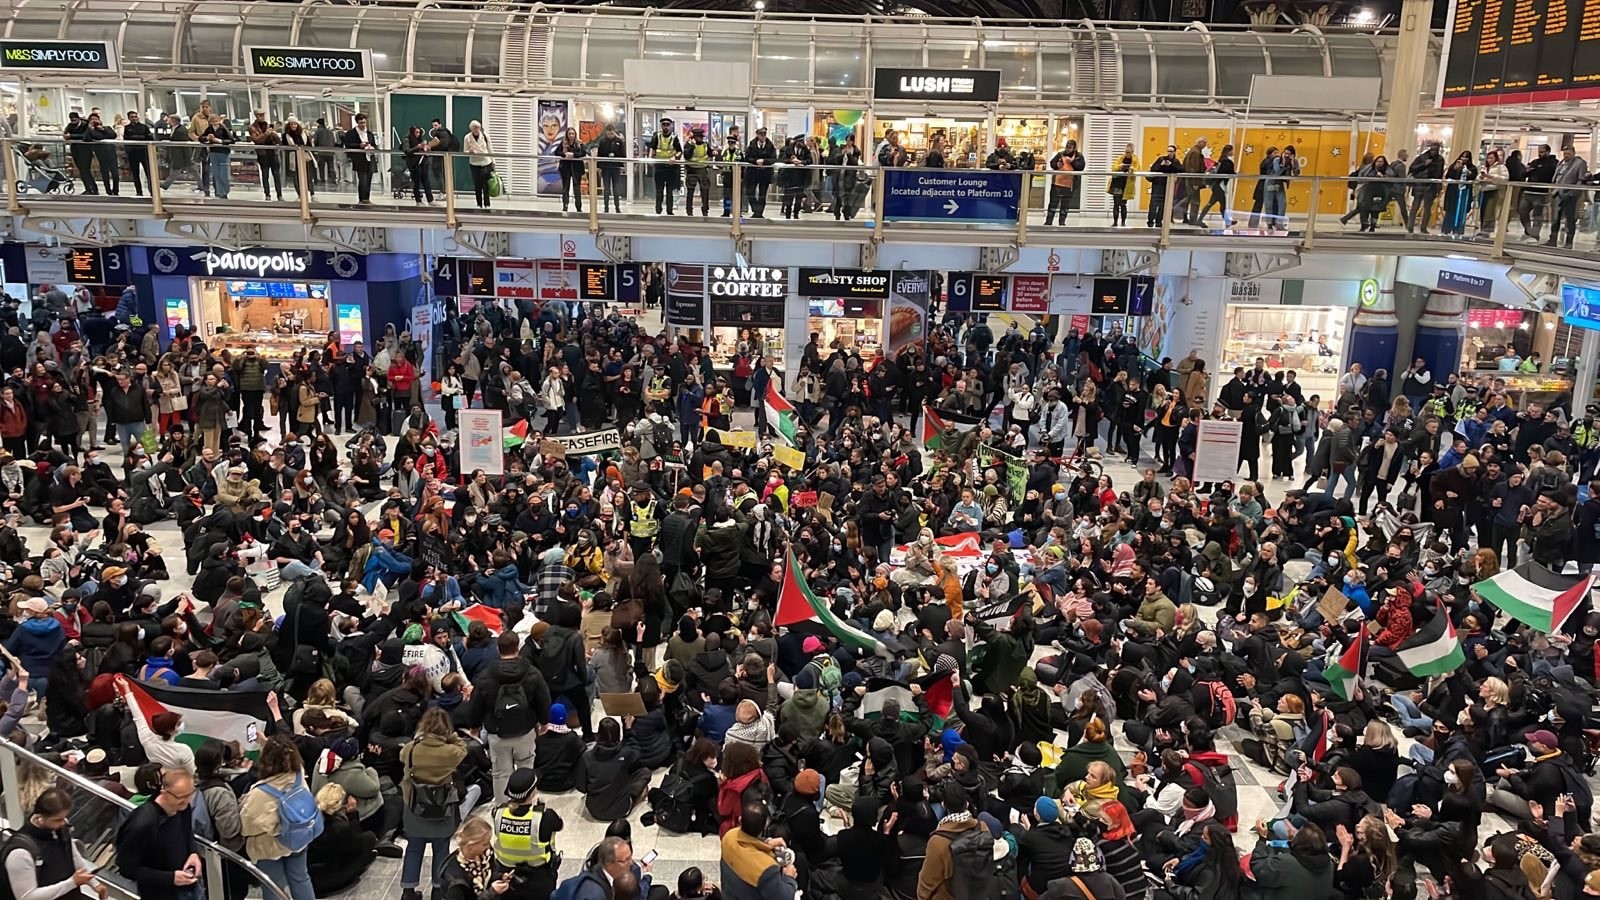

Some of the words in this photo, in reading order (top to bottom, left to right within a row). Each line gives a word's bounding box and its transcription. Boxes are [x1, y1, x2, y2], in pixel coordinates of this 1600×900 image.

[6, 49, 31, 60] M&S
[31, 49, 66, 61] SIMPLY
[67, 50, 100, 62] FOOD
[259, 56, 285, 68] M&S
[286, 56, 321, 69] SIMPLY
[322, 58, 356, 70] FOOD
[900, 76, 950, 93] LUSH
[918, 177, 956, 186] Customer
[958, 178, 988, 187] Lounge
[891, 187, 920, 196] located
[922, 189, 955, 198] adjacent
[967, 190, 1001, 198] Platform
[1003, 190, 1014, 198] 10
[108, 252, 121, 270] 3
[206, 251, 306, 277] panopolis
[438, 263, 452, 280] 4
[622, 270, 634, 287] 5
[726, 267, 770, 281] AMT
[856, 276, 887, 285] SHOP
[712, 281, 783, 297] COFFEE
[954, 280, 967, 296] 6
[1136, 283, 1149, 296] 7
[1231, 282, 1260, 296] wasabi
[500, 824, 530, 834] POLICE
